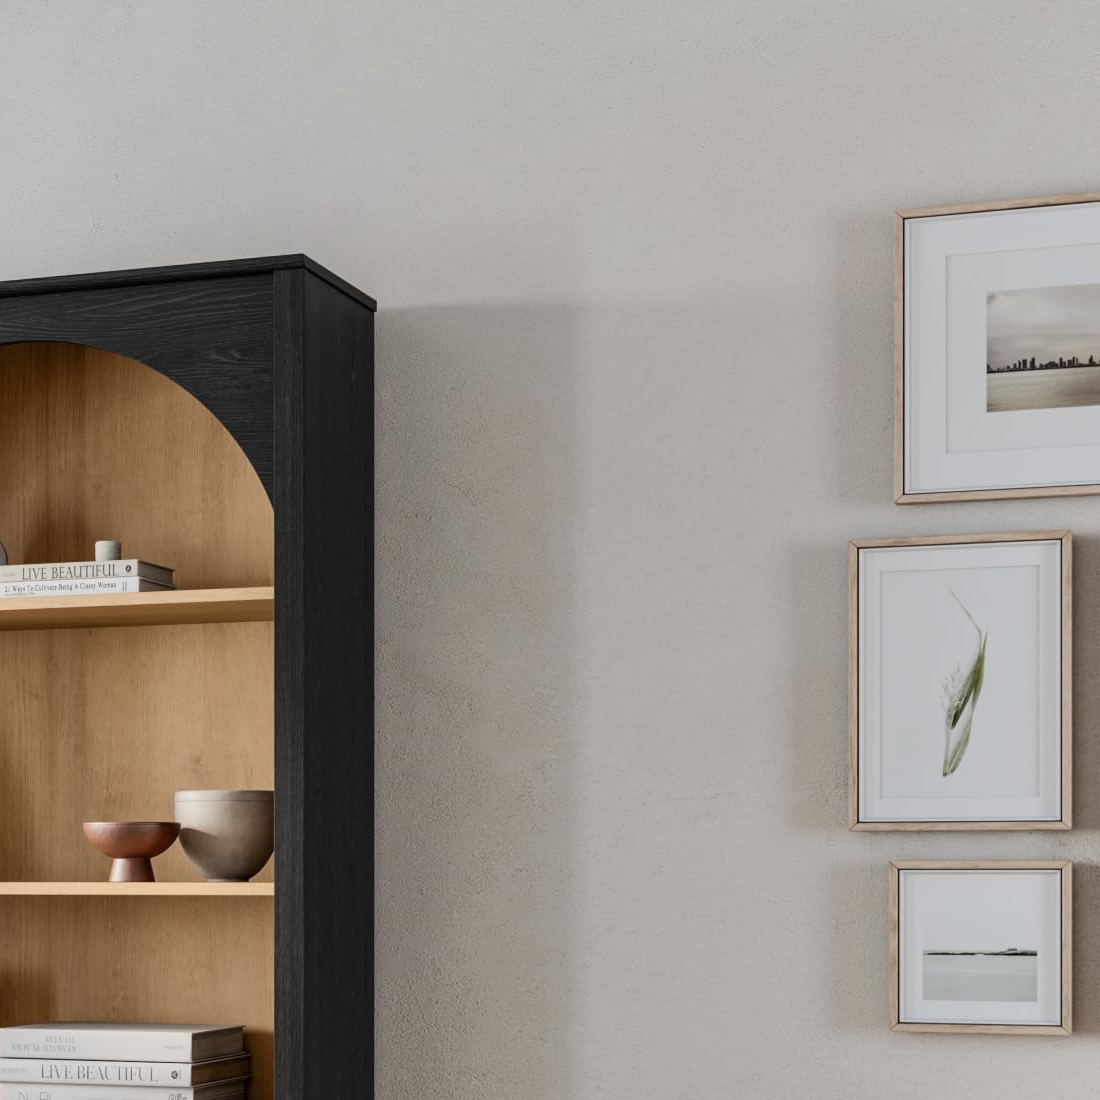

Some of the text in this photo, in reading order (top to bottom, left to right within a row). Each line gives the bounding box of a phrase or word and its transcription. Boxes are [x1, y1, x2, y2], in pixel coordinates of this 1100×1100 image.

[22, 567, 48, 580] LIVE
[51, 564, 118, 579] BEAUTIFUL
[4, 585, 10, 593] 21
[12, 585, 26, 593] Ways
[58, 583, 73, 591] Being
[80, 582, 96, 590] Classy
[97, 581, 117, 589] Woman
[41, 1064, 73, 1079] LIVE
[77, 1065, 159, 1081] BEAUTIFUL
